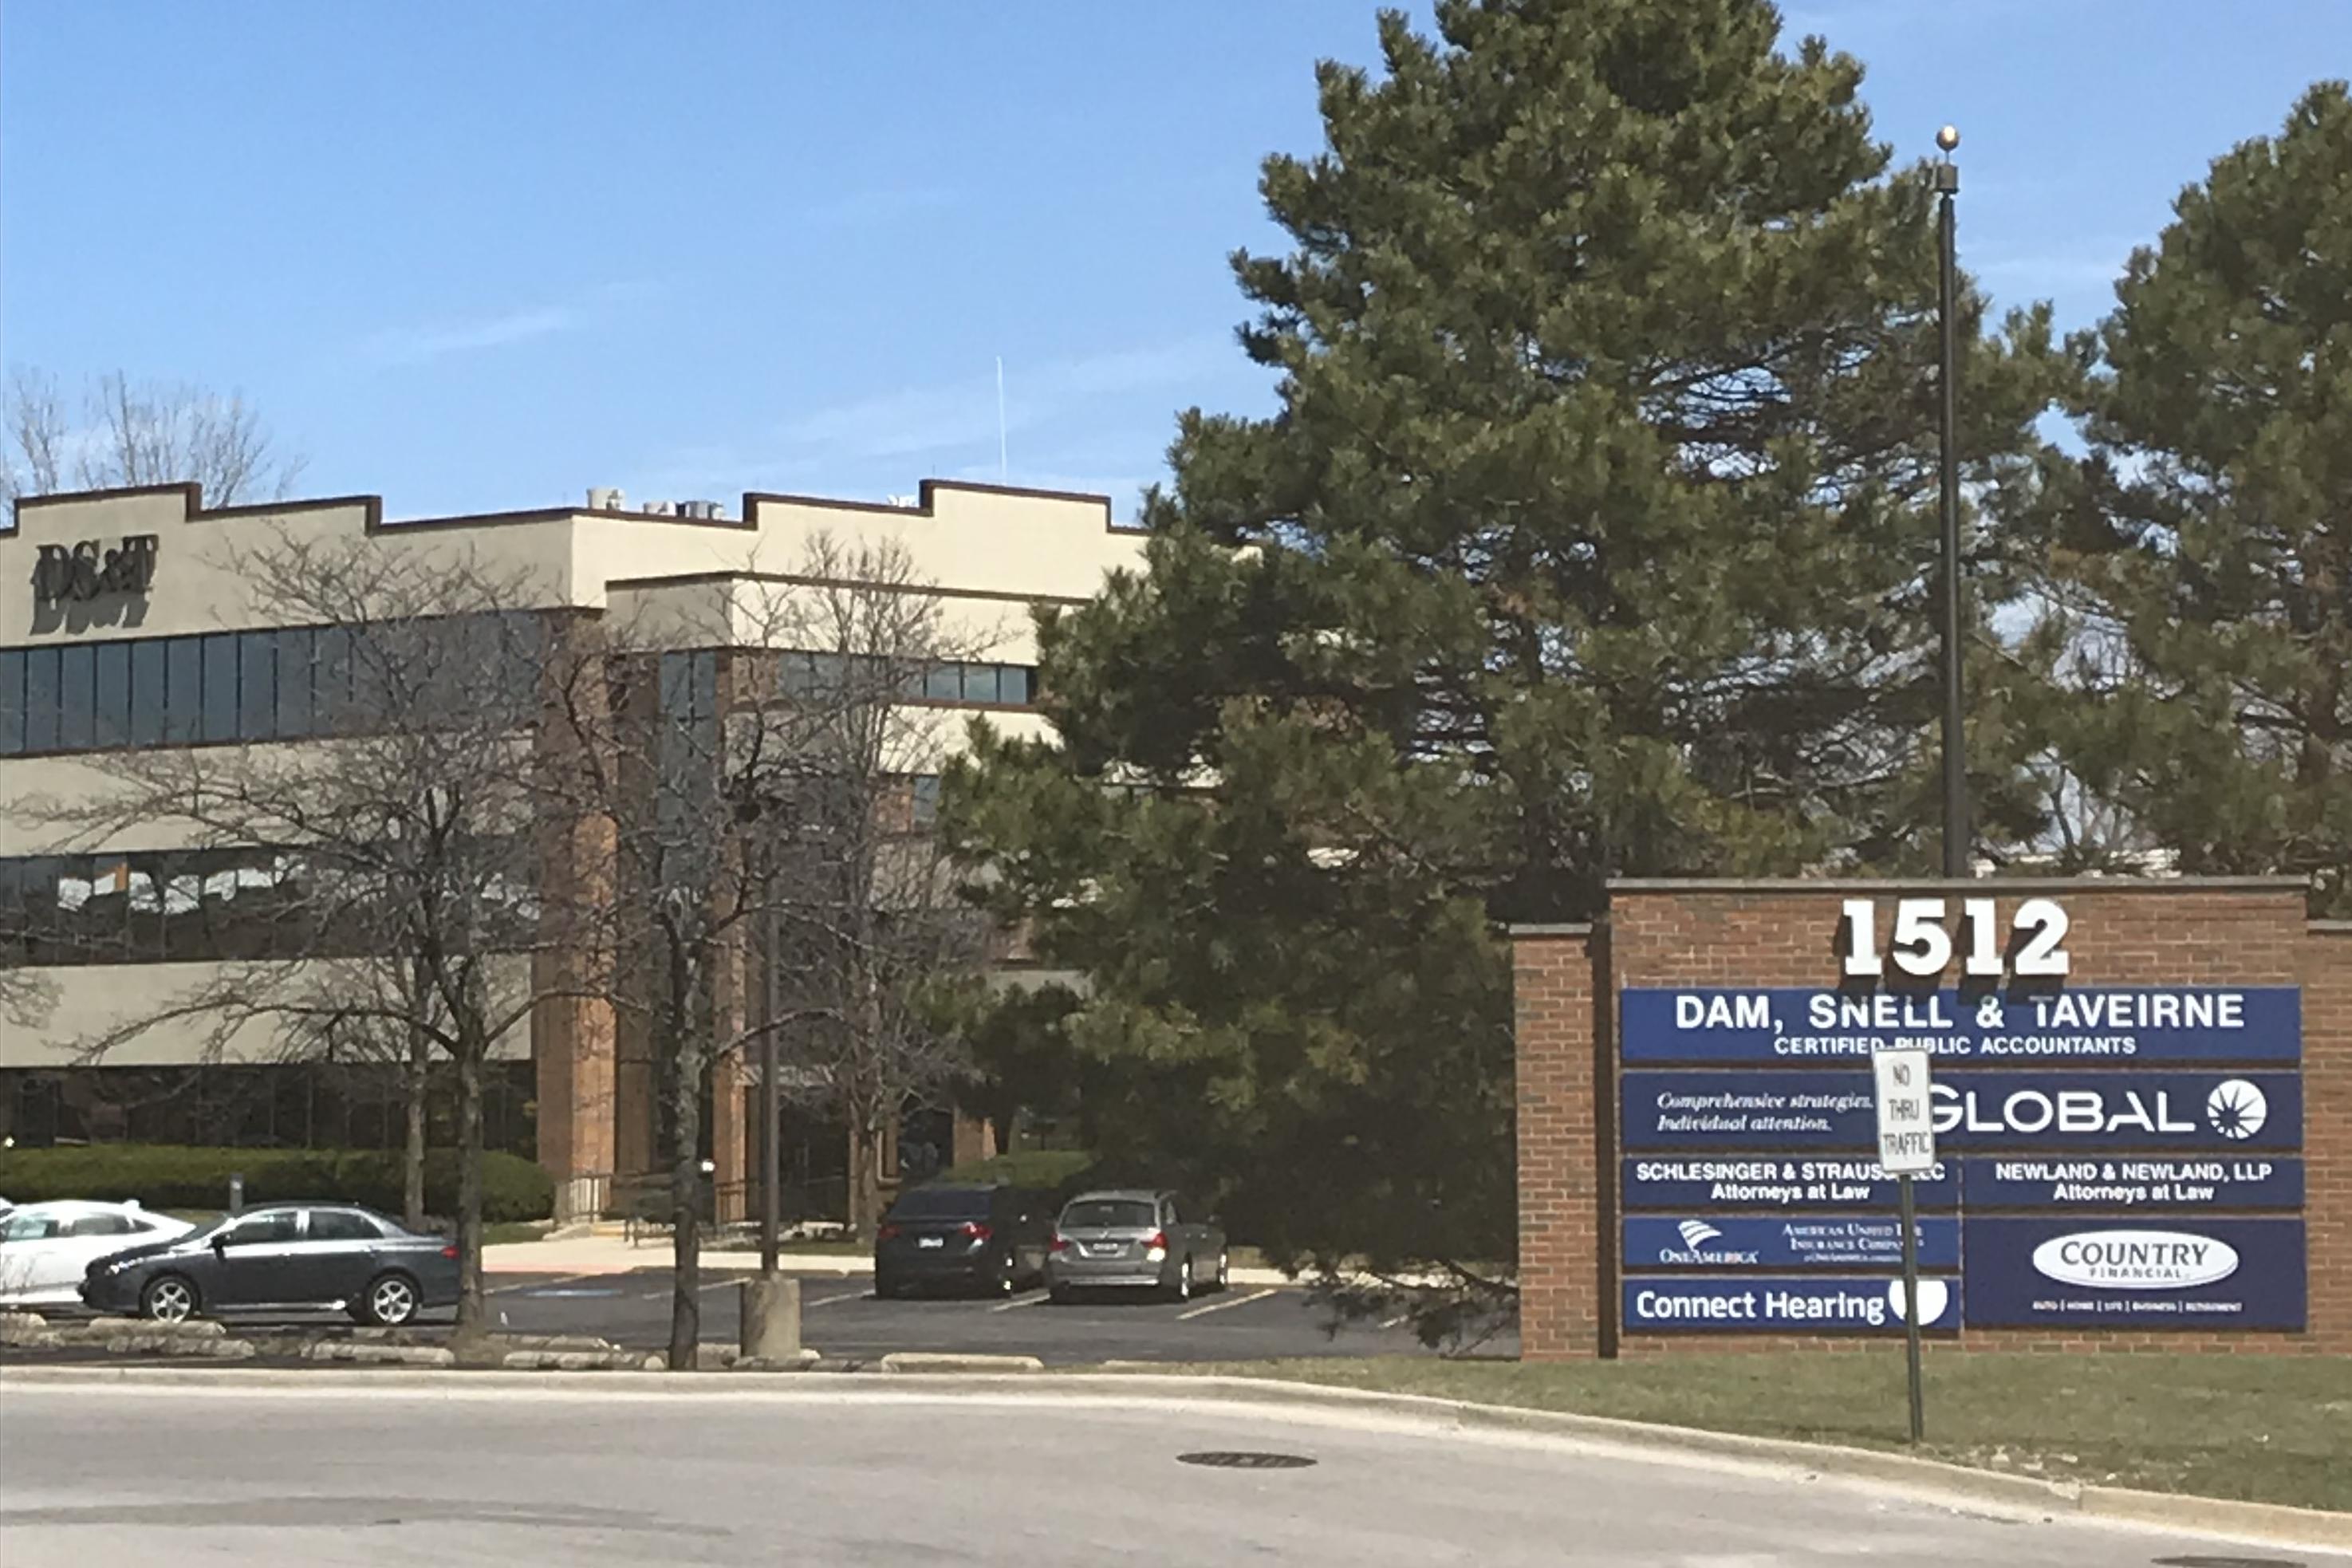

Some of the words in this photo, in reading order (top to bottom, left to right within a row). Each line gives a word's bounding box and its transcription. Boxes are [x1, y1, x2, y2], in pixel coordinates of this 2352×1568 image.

[1842, 898, 2070, 975] 1512
[1676, 995, 1784, 1034] DAM,
[1808, 994, 1954, 1030] SNELL
[1975, 995, 2005, 1029] &
[2028, 994, 2245, 1028] TAVEIRNE
[1774, 1036, 1885, 1054] CERTIFIED
[1894, 1036, 1972, 1054] PUBLIC
[1980, 1036, 2137, 1054] ACCOUNTANTS
[1893, 1065, 1911, 1087] NO
[1657, 1092, 1786, 1112] Comprehensive
[1888, 1098, 1921, 1121] THRU
[1931, 1084, 2196, 1133] GLOBAL
[1657, 1115, 1747, 1131] Individual
[1750, 1115, 1833, 1131] attention.
[1883, 1133, 1929, 1156] TRAFFIC
[1637, 1162, 1778, 1181] SCHLESINGER
[1781, 1162, 1797, 1181] &
[1995, 1163, 2098, 1181] NEWLAND
[2102, 1163, 2117, 1181] &
[2122, 1163, 2231, 1183] NEWLAND,
[2235, 1163, 2273, 1181] LLP
[1710, 1183, 1803, 1204] Attorneys
[1806, 1184, 1827, 1200] at
[1831, 1183, 1870, 1200] Law
[2053, 1183, 2147, 1204] Attorneys
[2151, 1184, 2171, 1200] at
[2174, 1184, 2215, 1200] Law
[2060, 1241, 2209, 1267] COUNTRY
[2089, 1267, 2181, 1278] FINANCIAL
[1637, 1291, 1757, 1319] Connect
[1766, 1291, 1885, 1325] Hearing
